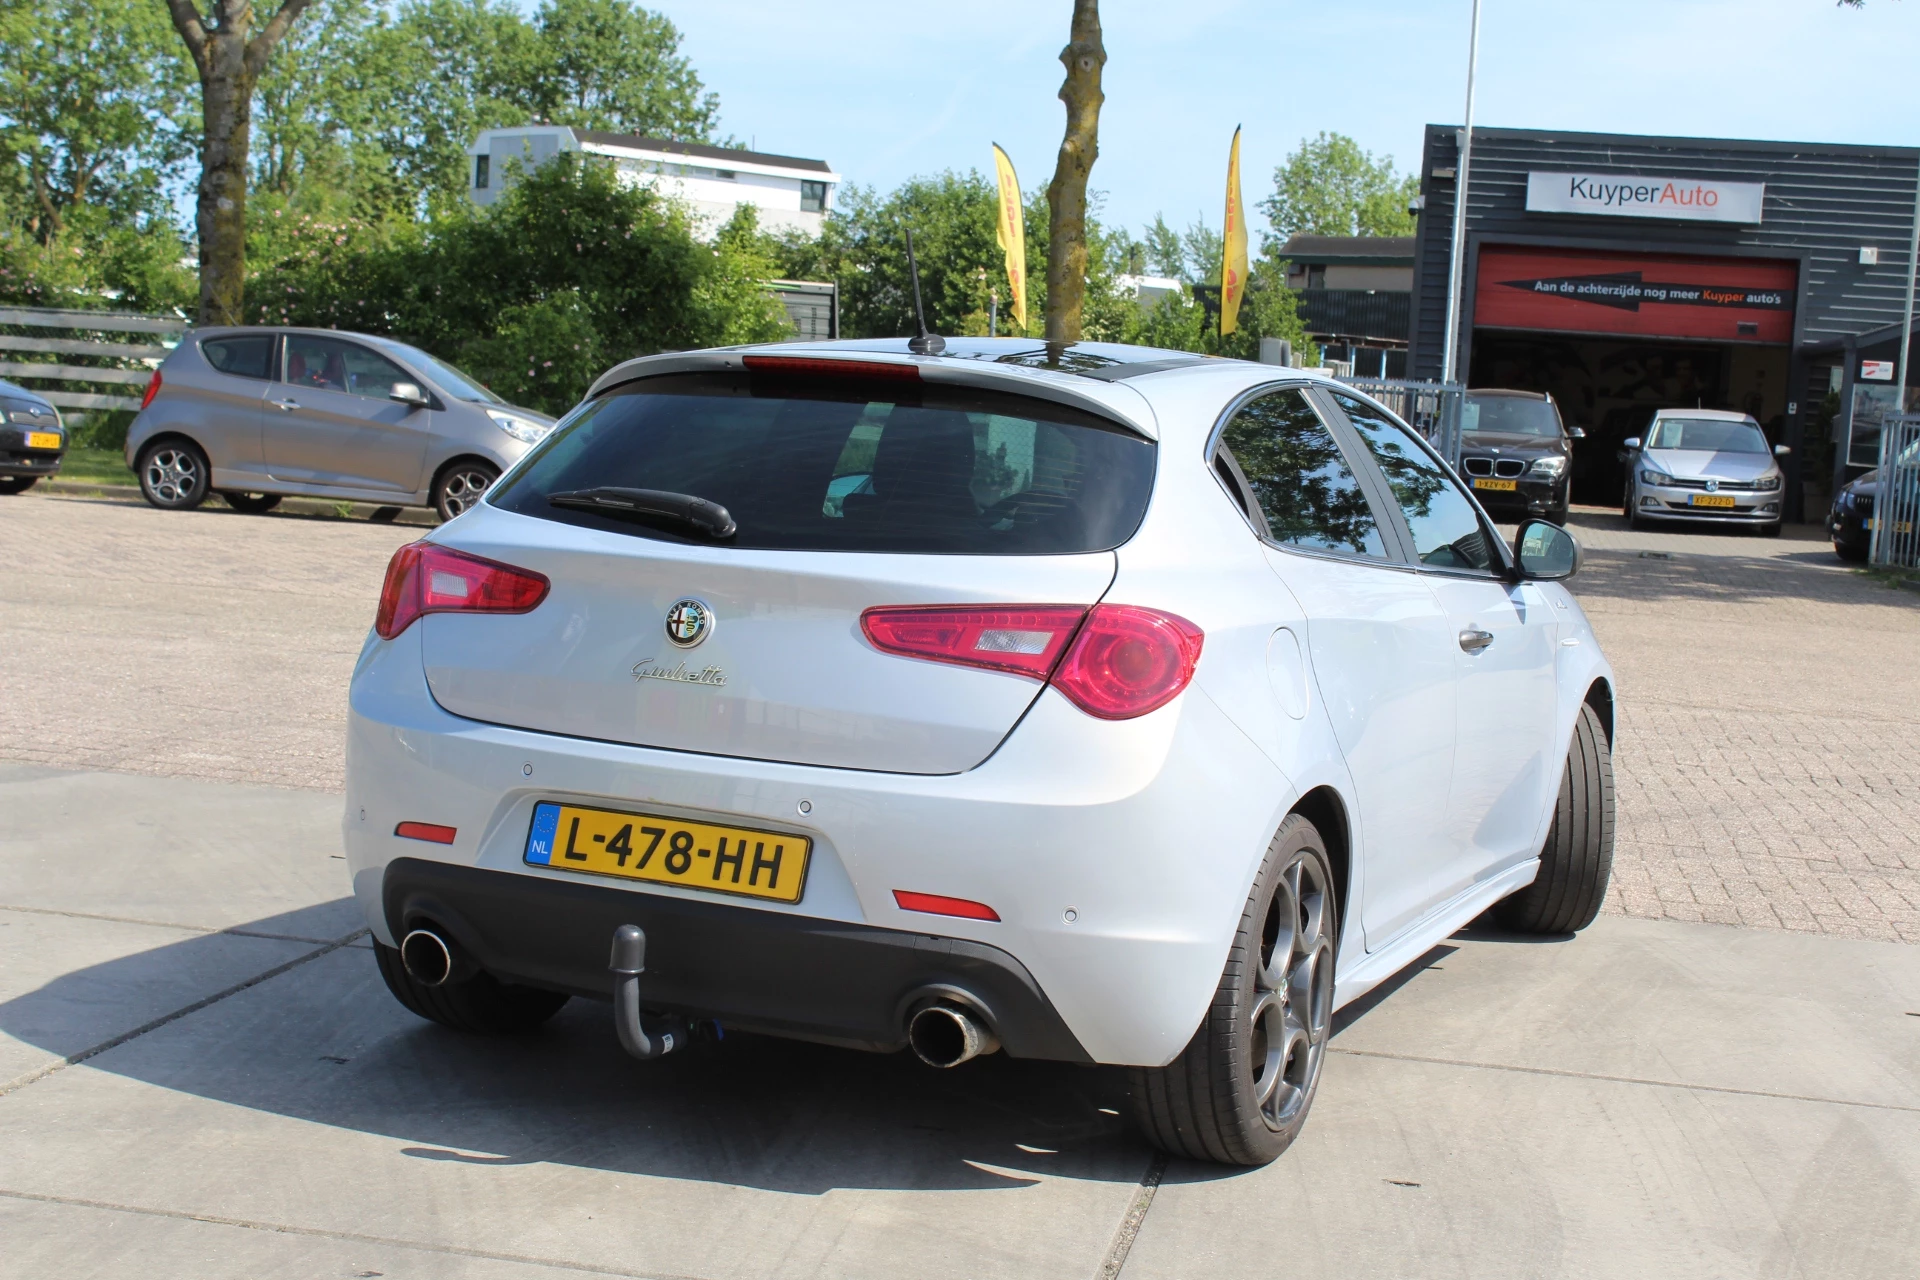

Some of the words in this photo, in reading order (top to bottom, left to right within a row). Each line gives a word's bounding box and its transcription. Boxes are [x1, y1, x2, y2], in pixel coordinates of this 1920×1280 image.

[1570, 177, 1718, 207] KuyperAuto
[1534, 281, 1557, 292] Aan
[1560, 282, 1575, 293] de
[1577, 283, 1641, 298] achterzijde
[1644, 289, 1667, 300] nog
[1670, 290, 1700, 300] meer
[1703, 290, 1745, 303] Kuyper
[1747, 293, 1781, 304] auto's
[687, 602, 705, 625] ROMEO
[631, 658, 728, 686] Giulietta
[531, 839, 549, 855] NL
[564, 817, 784, 889] L-478-HH
